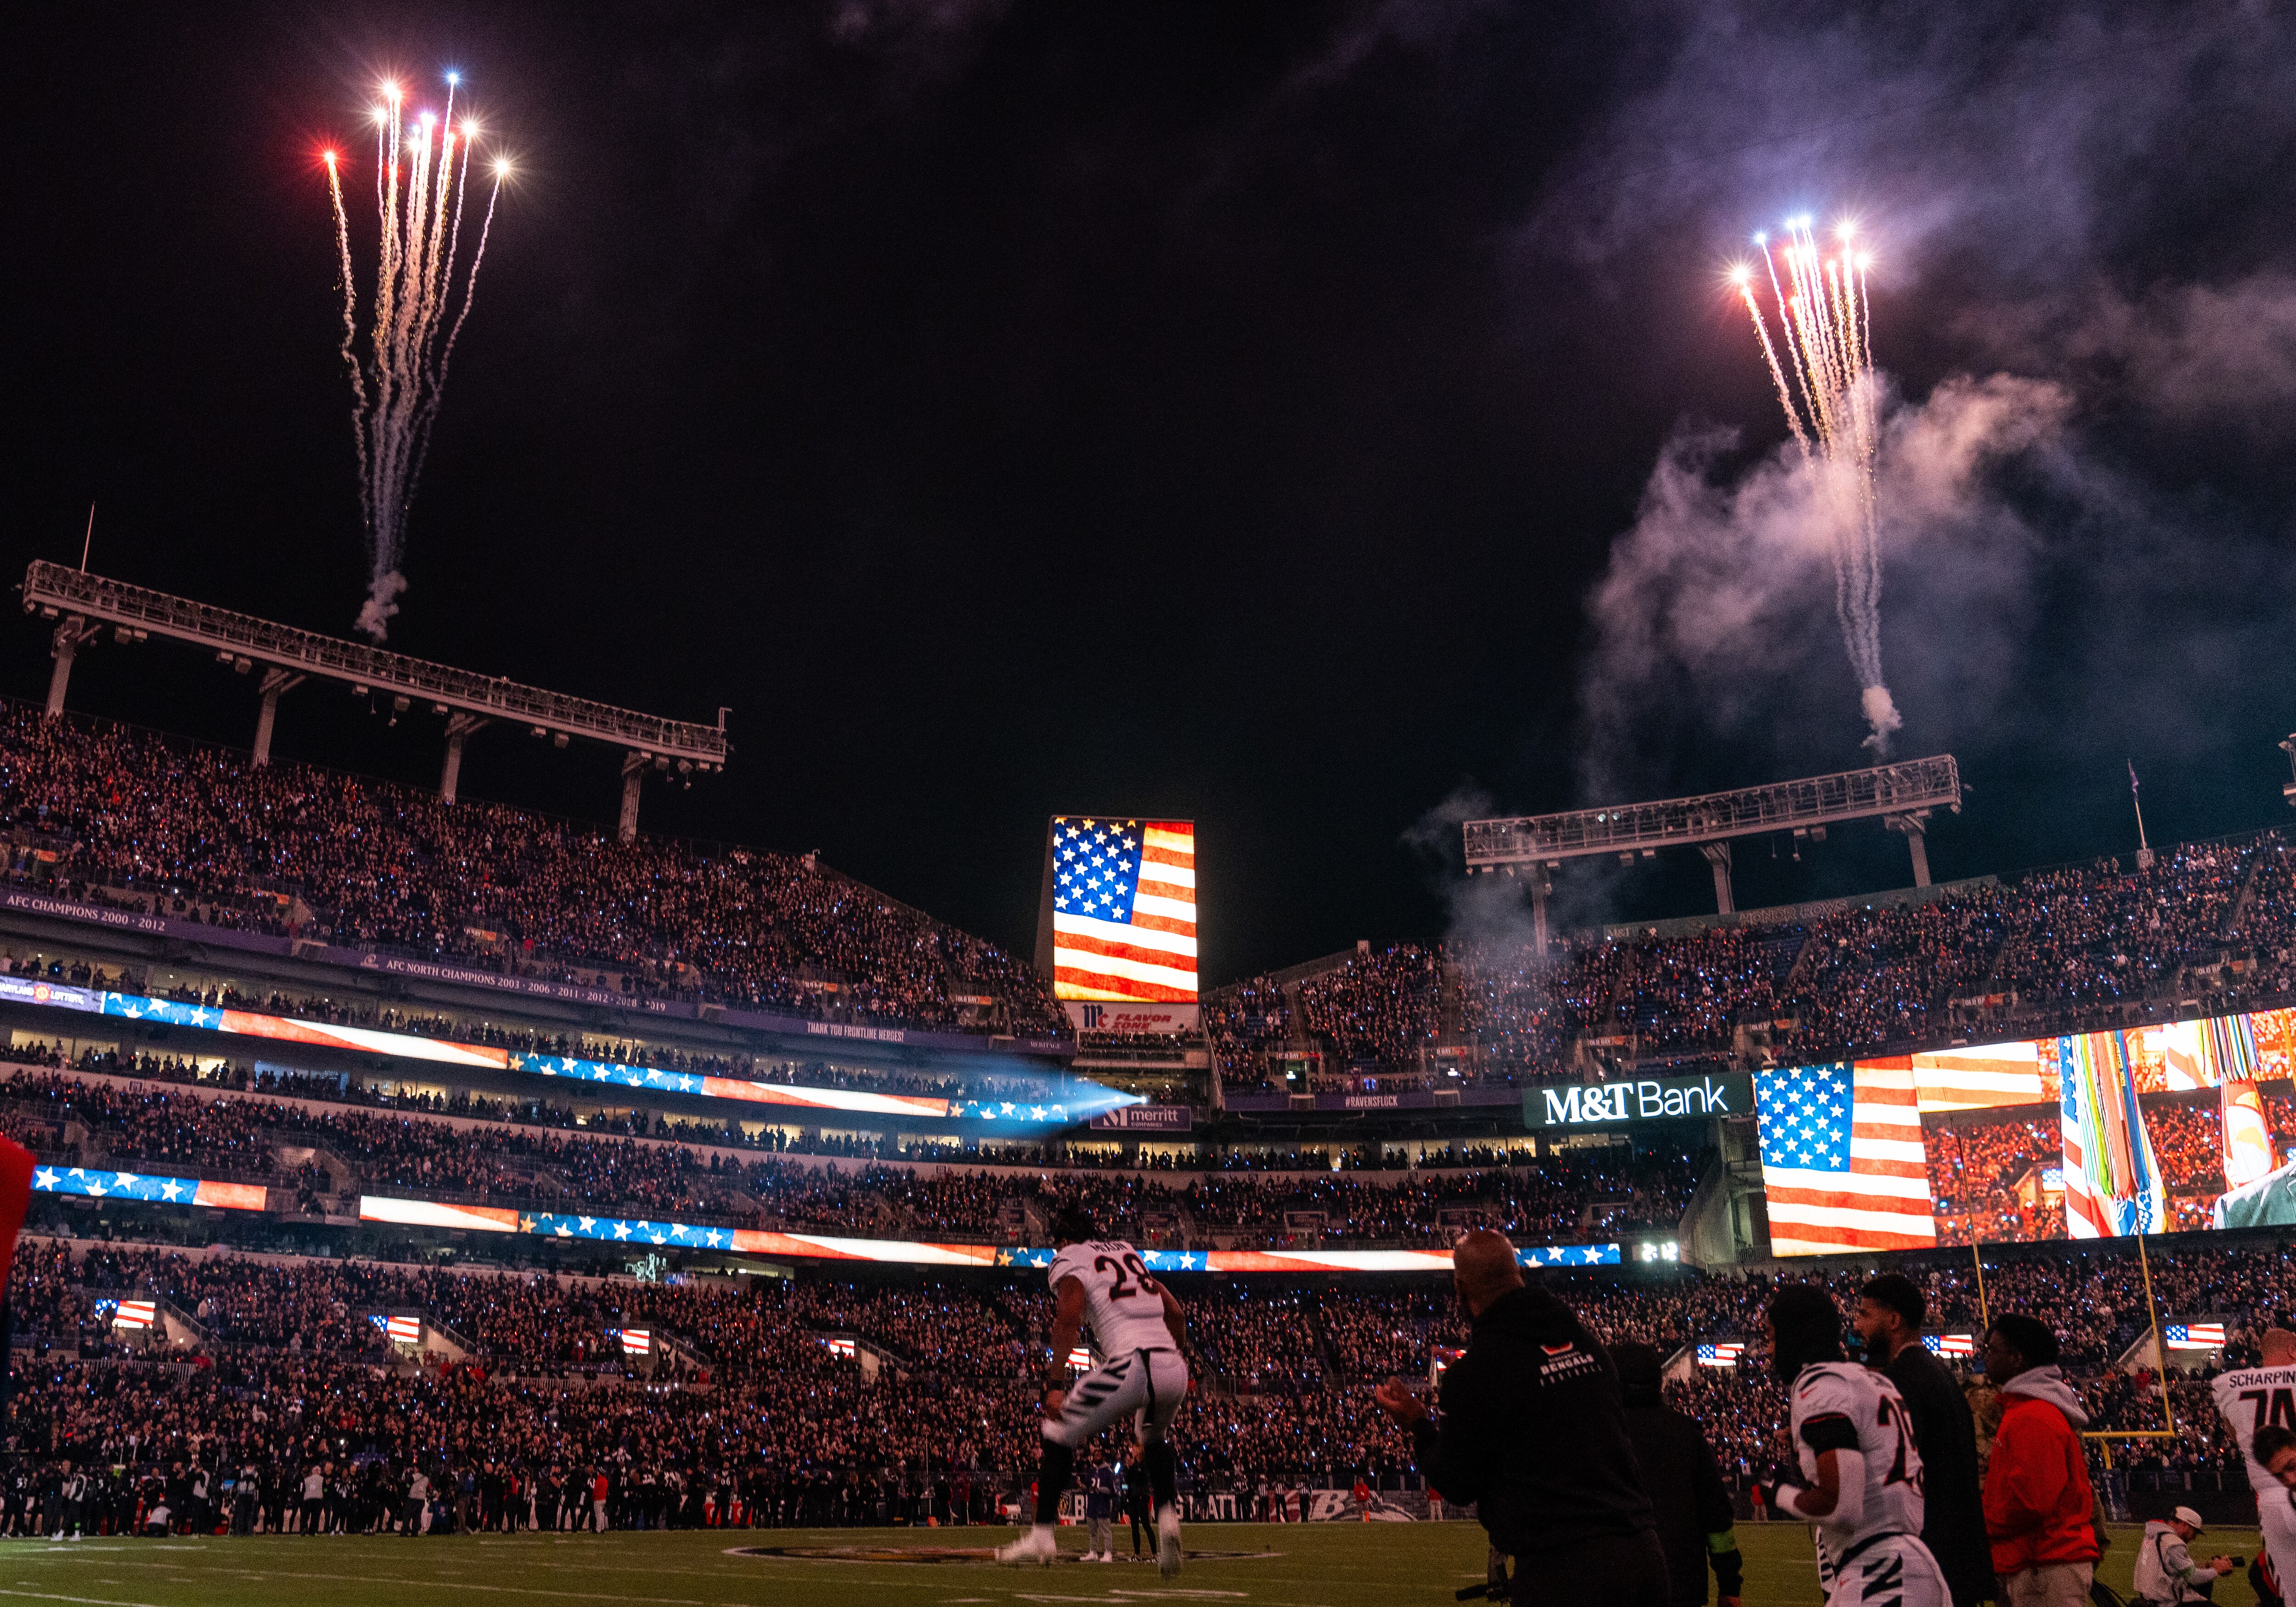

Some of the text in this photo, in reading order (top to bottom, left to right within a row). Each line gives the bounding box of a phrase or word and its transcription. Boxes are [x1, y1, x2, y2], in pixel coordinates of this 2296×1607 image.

[7, 895, 165, 932] AFC CHAMPIONS 2000 2012
[387, 959, 405, 971] AFC
[407, 964, 439, 976] NORTH
[441, 968, 495, 986] CHAMPIONS
[497, 976, 520, 989] 2003
[528, 982, 550, 994] 2006
[558, 987, 578, 999] 2011
[587, 992, 608, 1004] 2012
[645, 1001, 666, 1011] 019
[50, 992, 82, 1004] LOTTERY
[1115, 1013, 1171, 1022] FLAVOR
[808, 1021, 904, 1043] THANK YOU FRONTLINE HEROES!
[1345, 1095, 1398, 1108] #RAVENSFLOCK
[1542, 1077, 1729, 1125] M&T Bank
[1131, 1108, 1179, 1122] merritt
[1094, 1253, 1160, 1303] 28
[1539, 1353, 1594, 1375] BENGALS
